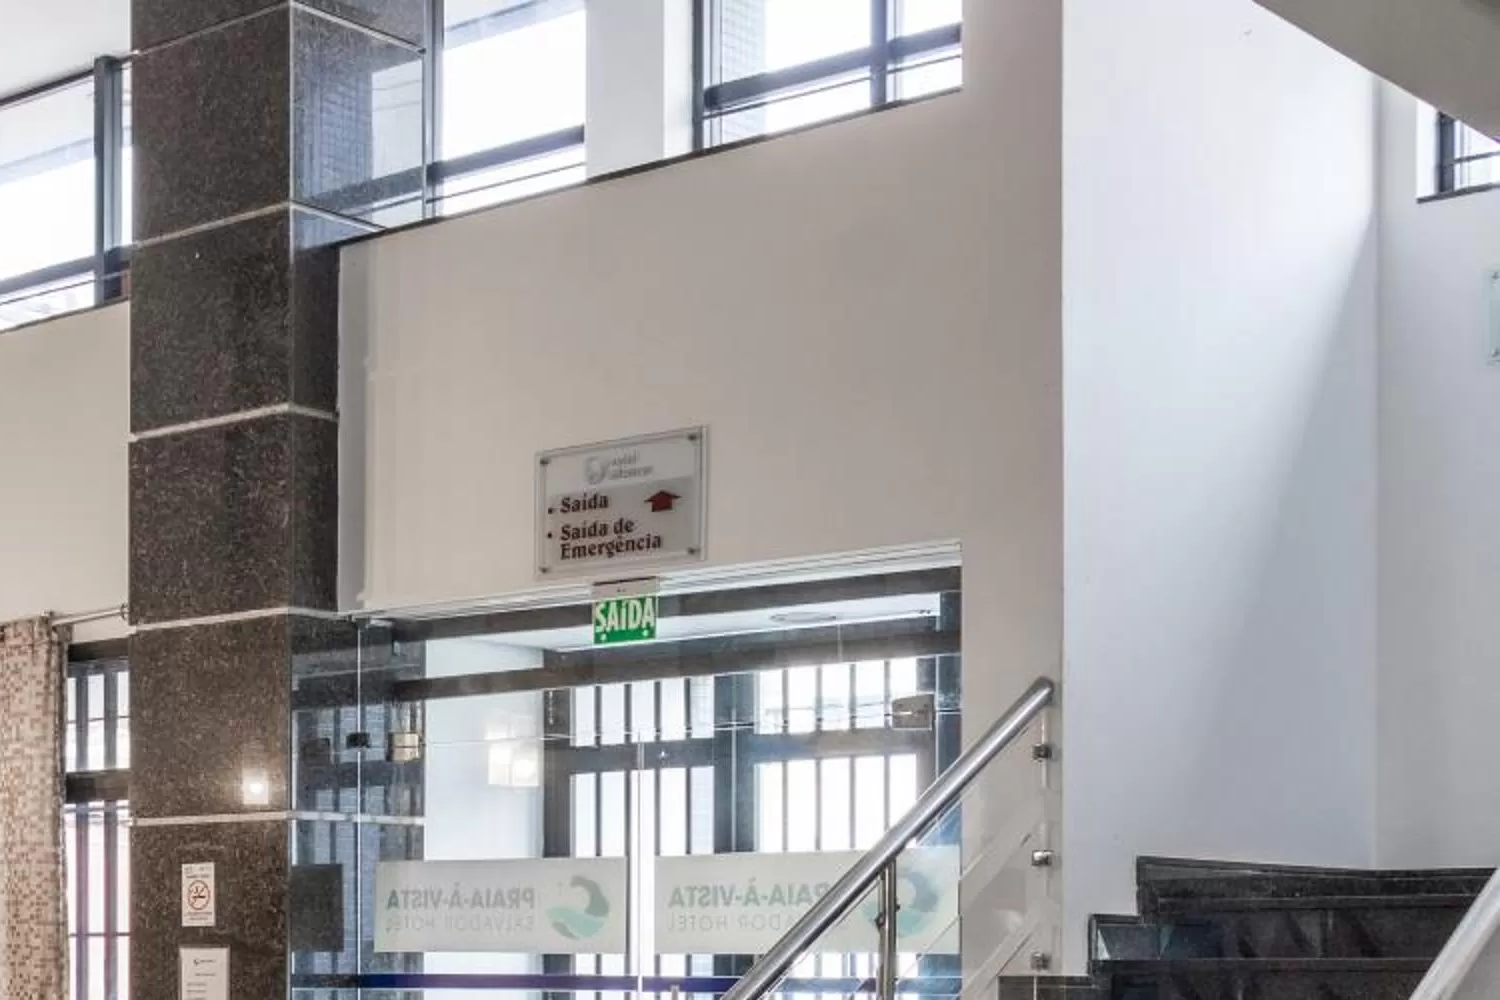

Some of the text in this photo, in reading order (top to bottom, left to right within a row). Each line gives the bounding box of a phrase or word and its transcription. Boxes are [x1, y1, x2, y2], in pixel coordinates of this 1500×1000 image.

[561, 492, 608, 513] Saída
[561, 517, 634, 541] Saída de
[561, 533, 662, 560] Emergência
